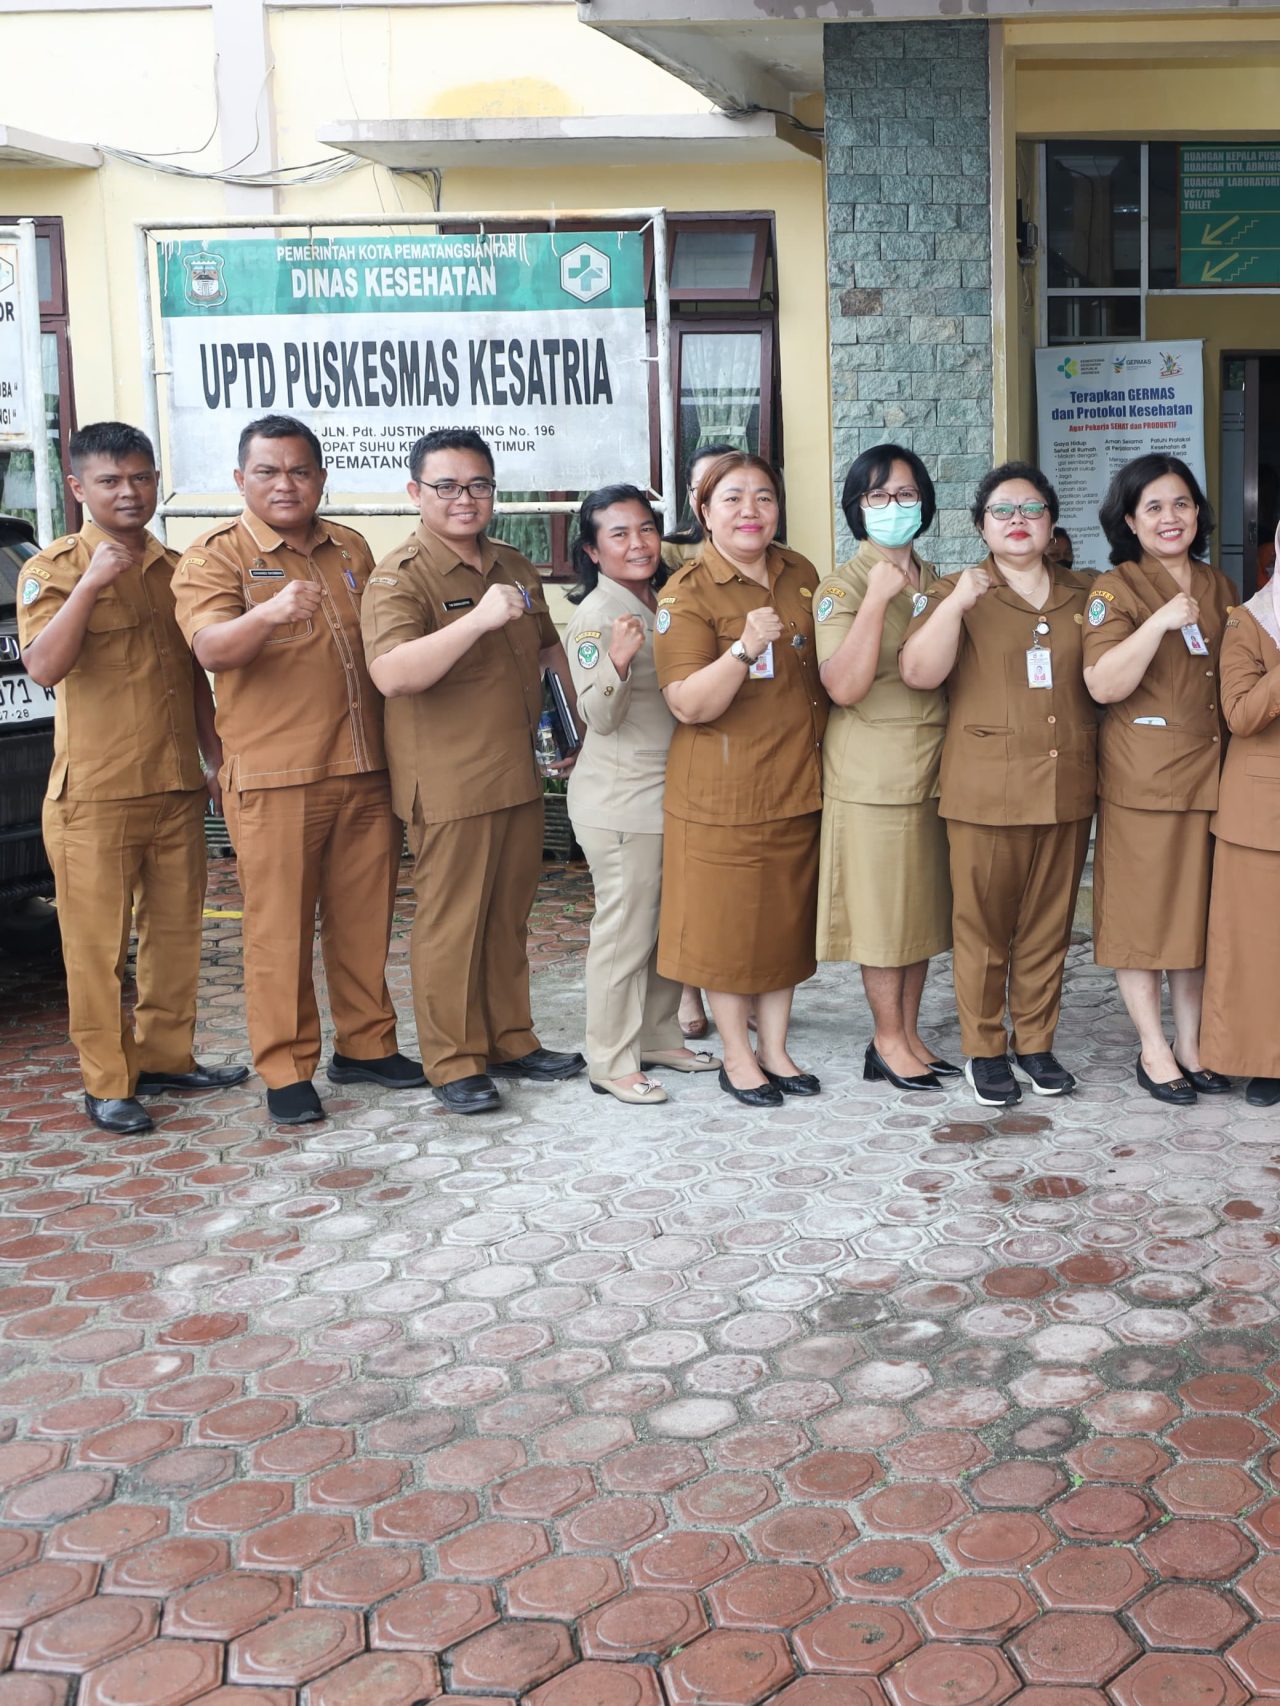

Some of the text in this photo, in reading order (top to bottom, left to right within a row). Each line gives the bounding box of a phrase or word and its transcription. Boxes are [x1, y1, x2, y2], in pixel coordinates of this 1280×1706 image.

[1184, 151, 1224, 161] RUANGAN
[1226, 151, 1257, 161] KEPALA
[1184, 162, 1224, 172] RUANGAN
[1184, 177, 1224, 187] RUANGAN
[1184, 188, 1220, 199] VCT/IMS
[1184, 200, 1211, 210] TOILET
[276, 245, 356, 261] PEMERINTAH
[359, 245, 392, 260] KOTA
[394, 243, 517, 259] PEMATANGSIANTAR
[292, 266, 497, 298] DINAS KESEHATAN
[199, 338, 613, 410] UPTD PUSKESMAS KESATRIA
[1070, 387, 1175, 403] Terapkan GERMAS
[1052, 404, 1193, 420] dan Protokol Kesehatan
[321, 426, 348, 437] JLN.
[353, 426, 376, 437] Pdt.
[380, 426, 425, 437] JUSTIN
[509, 426, 530, 436] No.
[534, 425, 555, 436] 196
[1111, 422, 1128, 430] SEHAT
[1143, 421, 1177, 429] PRODUKTIF
[322, 441, 355, 452] OPAT
[360, 441, 395, 452] SUHU
[494, 441, 536, 452] TIMUR
